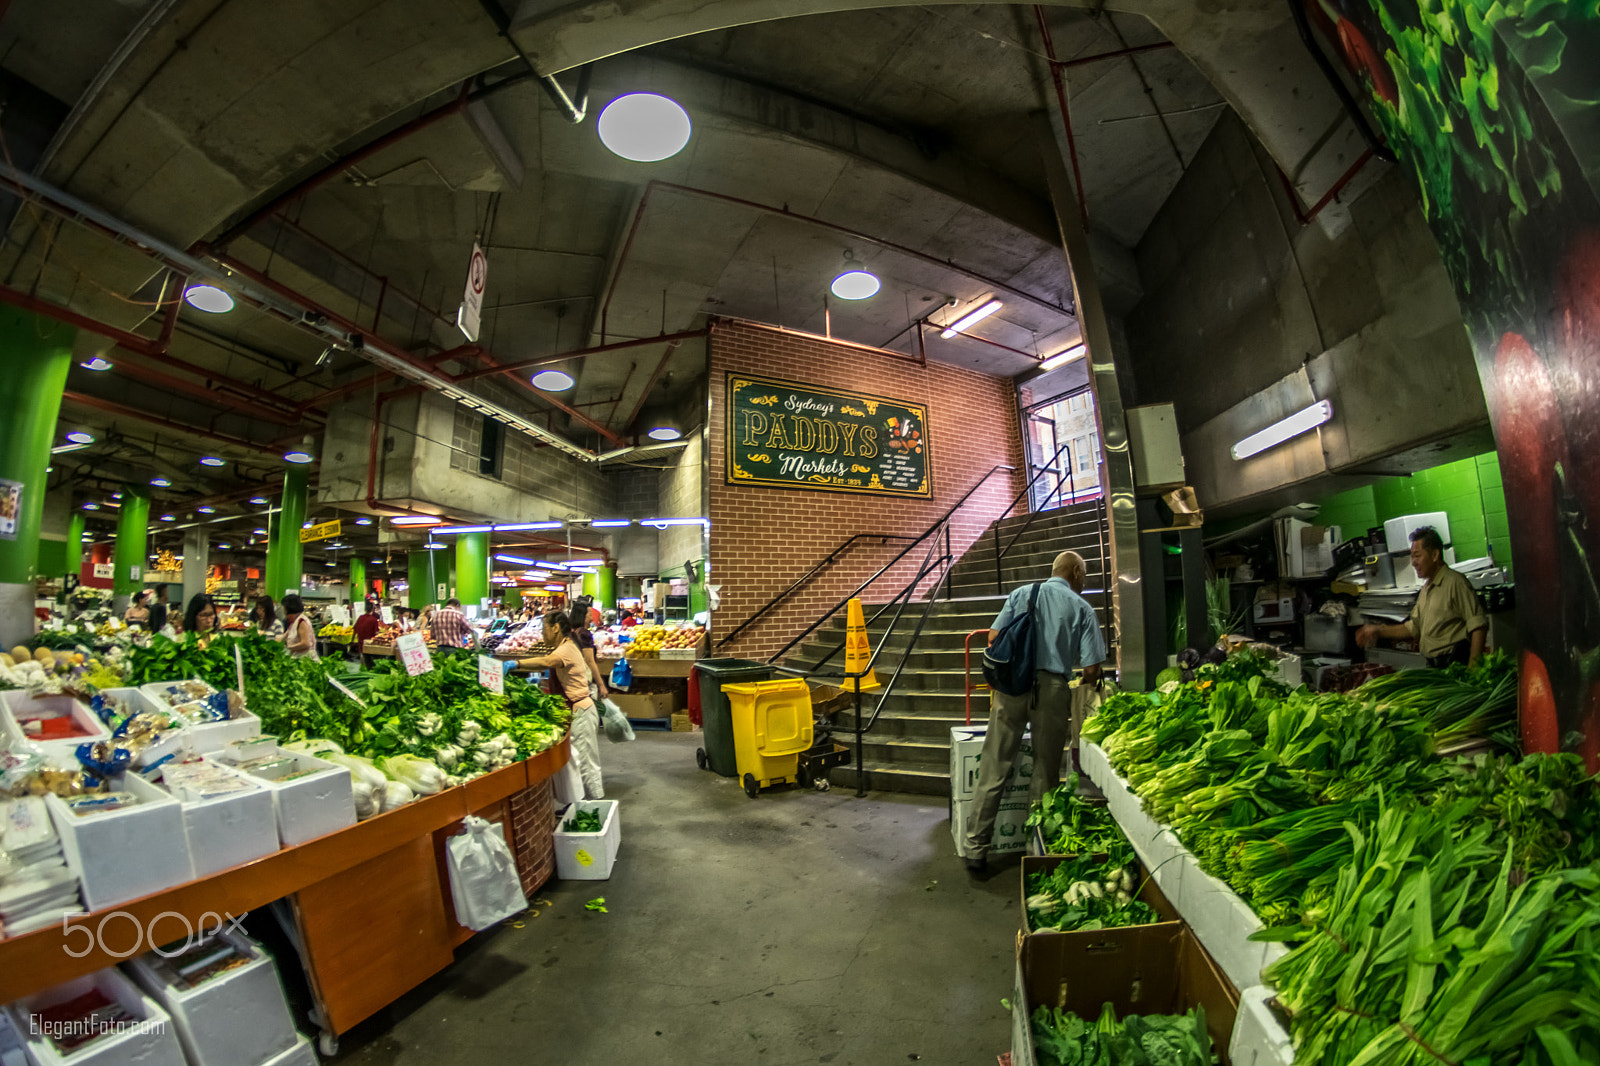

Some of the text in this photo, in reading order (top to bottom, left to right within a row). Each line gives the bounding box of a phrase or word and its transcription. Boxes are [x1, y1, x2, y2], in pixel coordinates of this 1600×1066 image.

[784, 394, 834, 416] Sydney's
[742, 409, 878, 458] PADDYS
[778, 453, 849, 479] Markets
